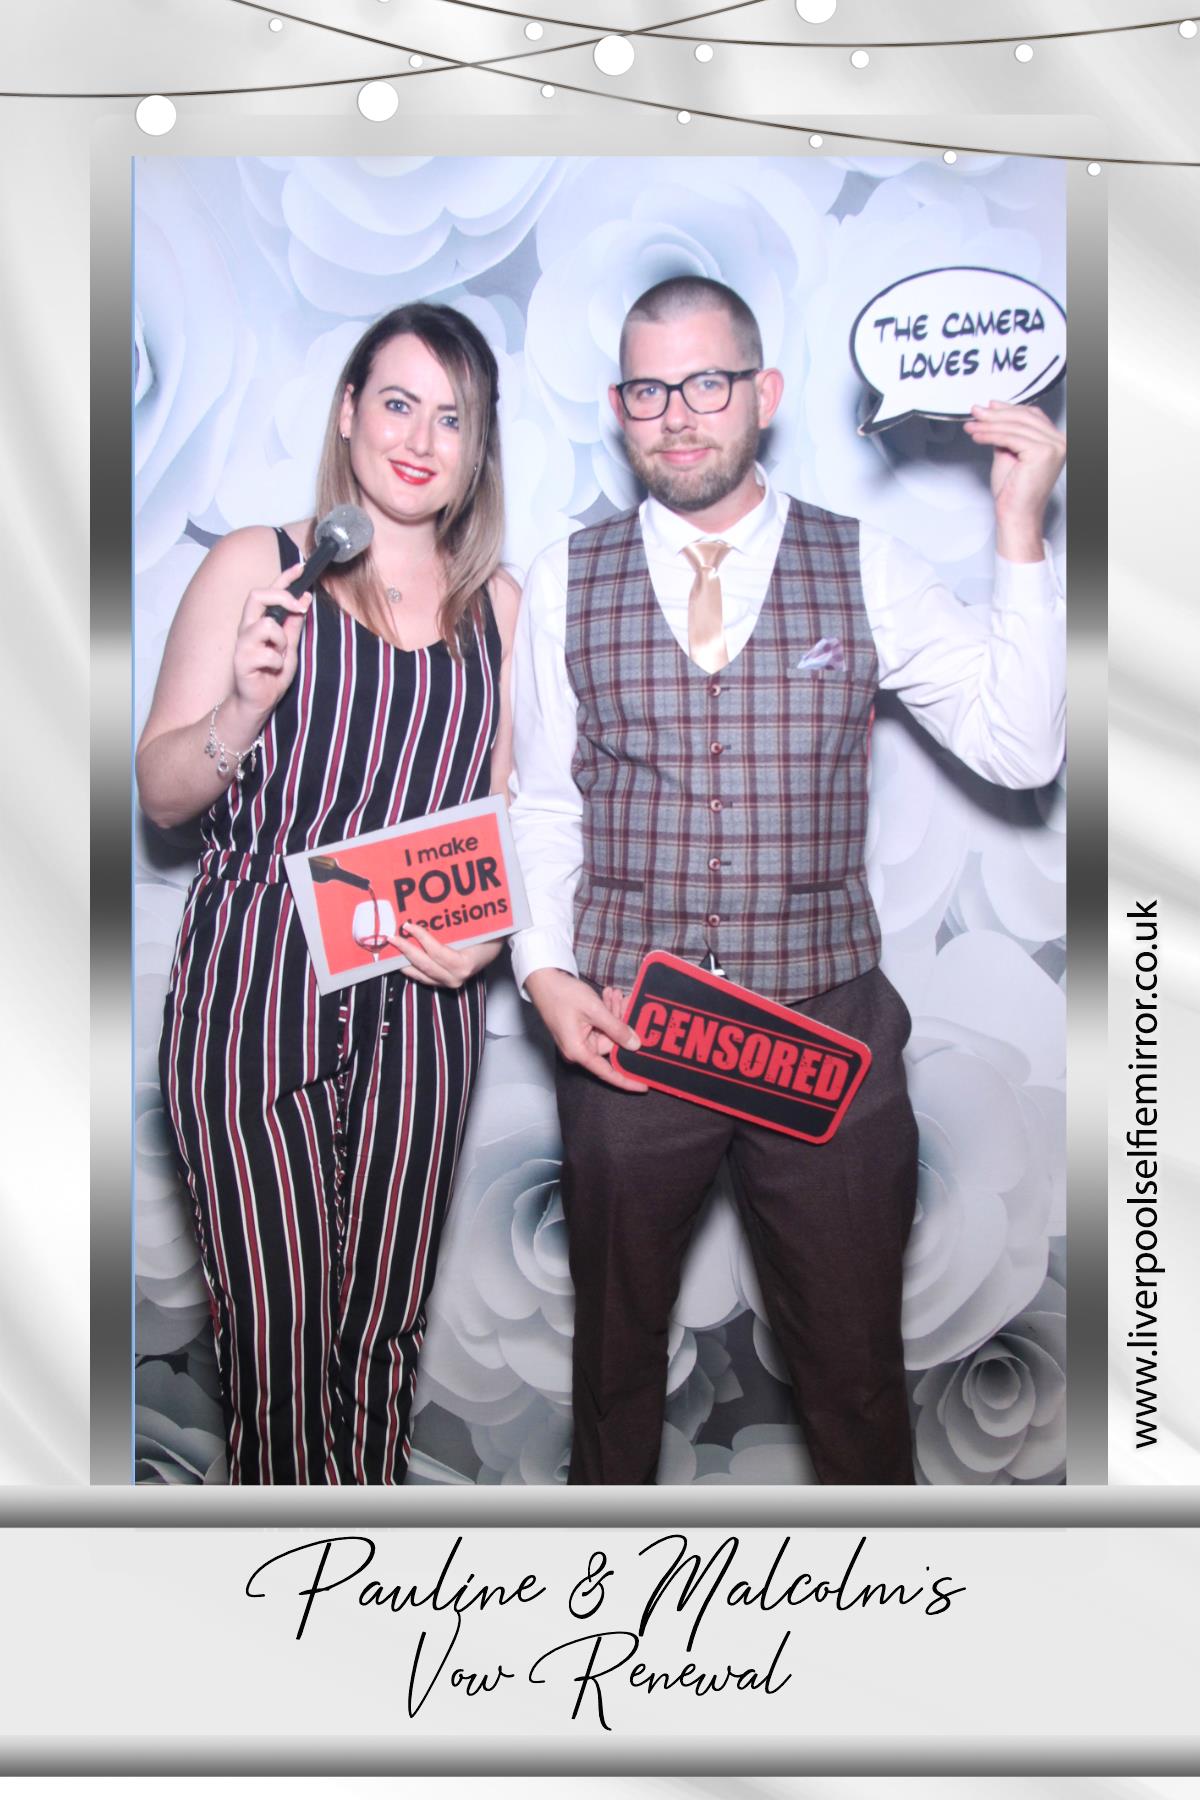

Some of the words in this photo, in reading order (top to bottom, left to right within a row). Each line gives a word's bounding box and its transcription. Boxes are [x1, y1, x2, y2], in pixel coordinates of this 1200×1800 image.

[873, 314, 929, 343] THE
[942, 308, 1045, 338] CAMERA
[899, 349, 979, 381] LOVES
[991, 345, 1028, 373] ME
[405, 848, 413, 867] I
[418, 836, 478, 864] make
[394, 856, 501, 912] POUR
[634, 1002, 849, 1101] CENSORED
